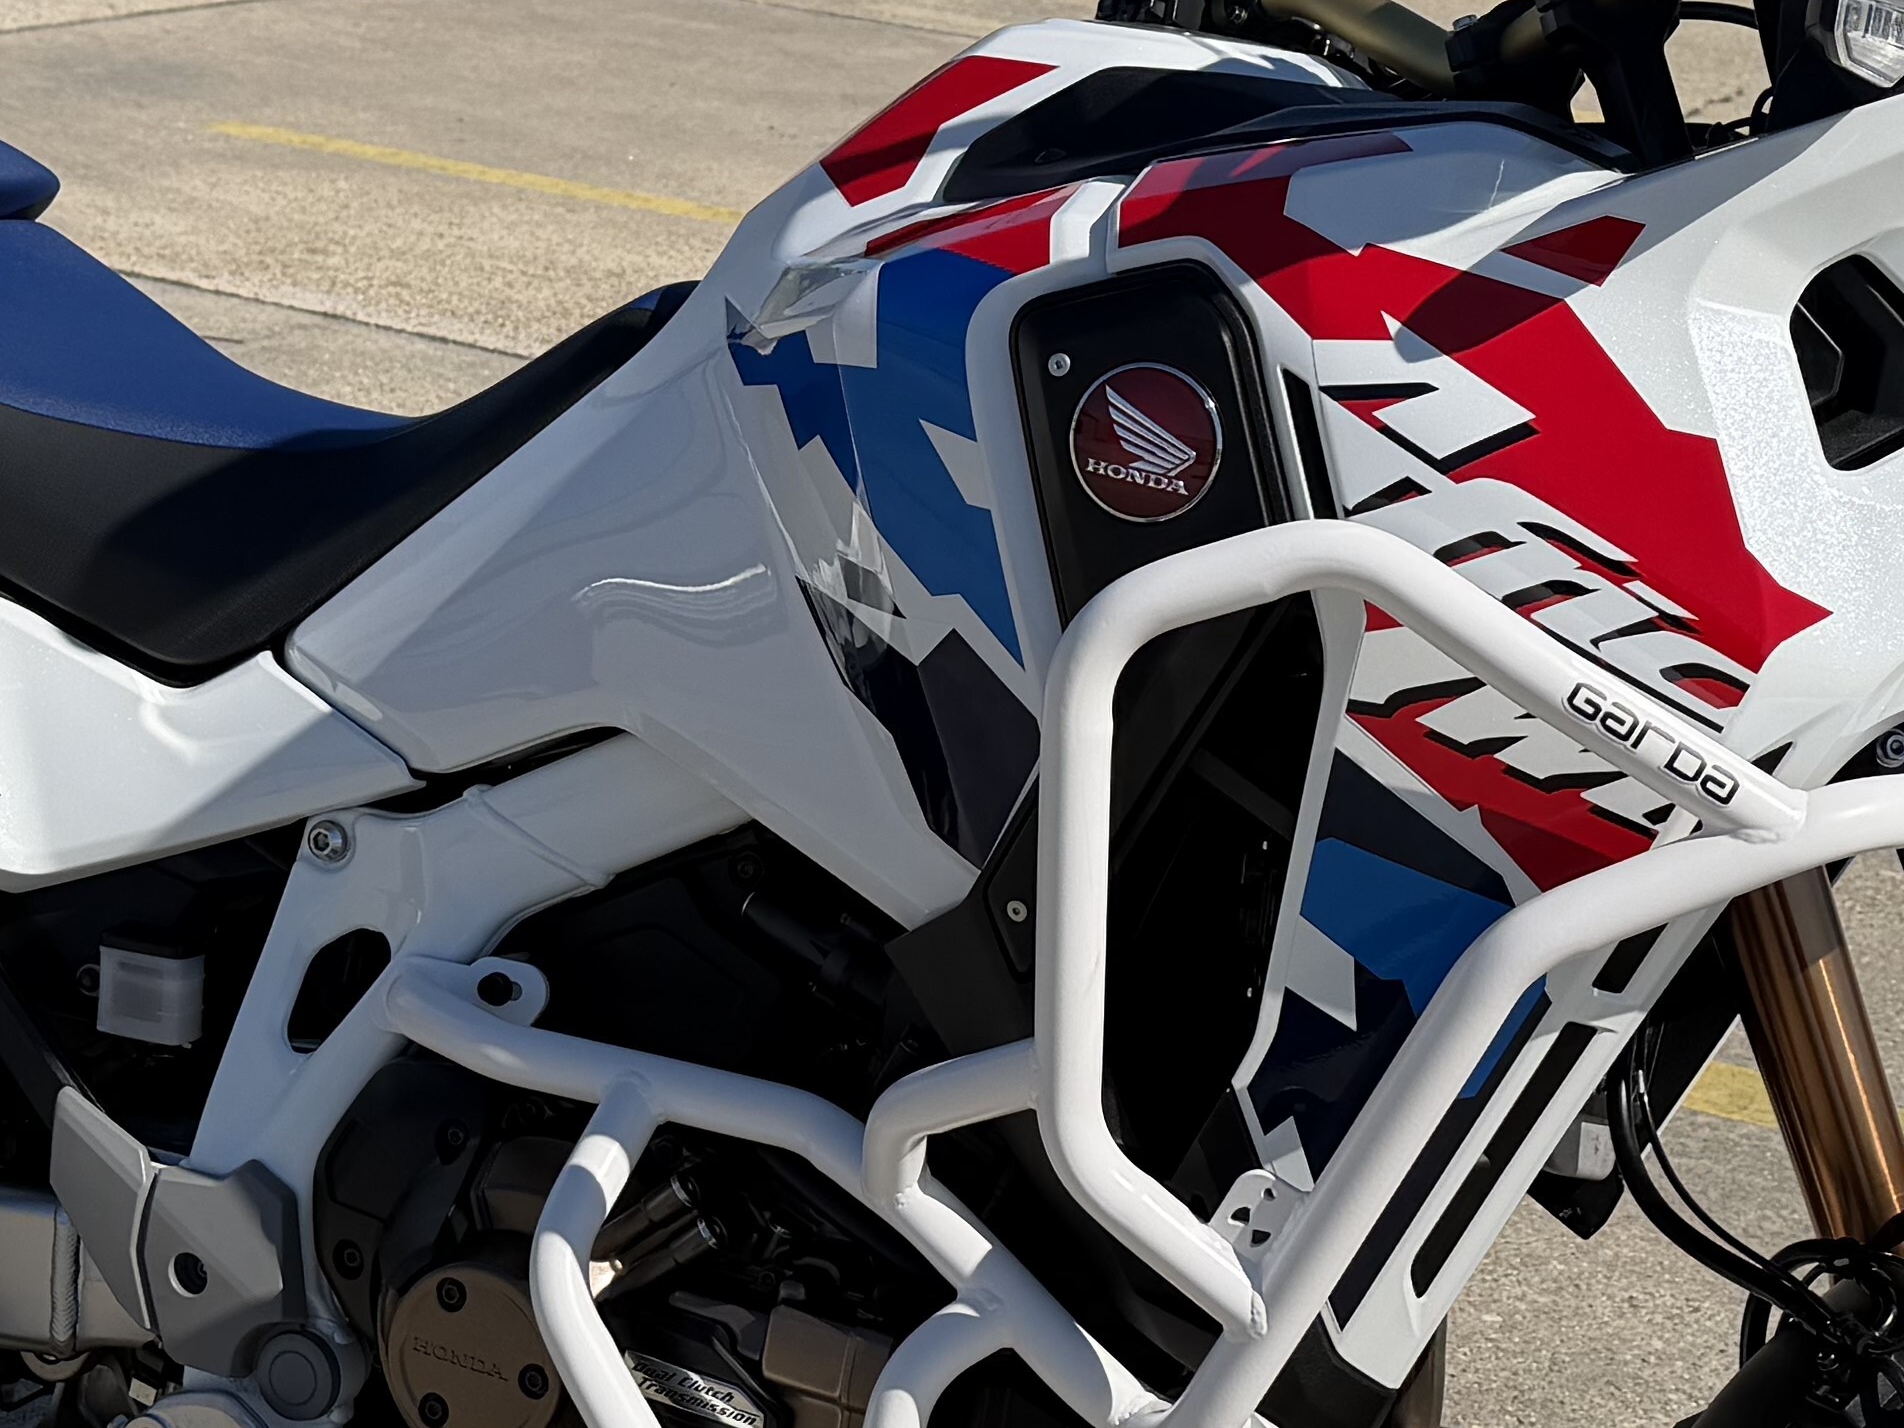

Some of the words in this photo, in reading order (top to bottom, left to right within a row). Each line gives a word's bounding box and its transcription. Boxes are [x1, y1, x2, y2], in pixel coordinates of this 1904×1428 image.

[1085, 457, 1190, 496] HONDA
[413, 1337, 508, 1382] HONDA
[632, 1362, 677, 1382] Dual
[678, 1374, 735, 1404] Clutch
[639, 1376, 758, 1426] Transmission
